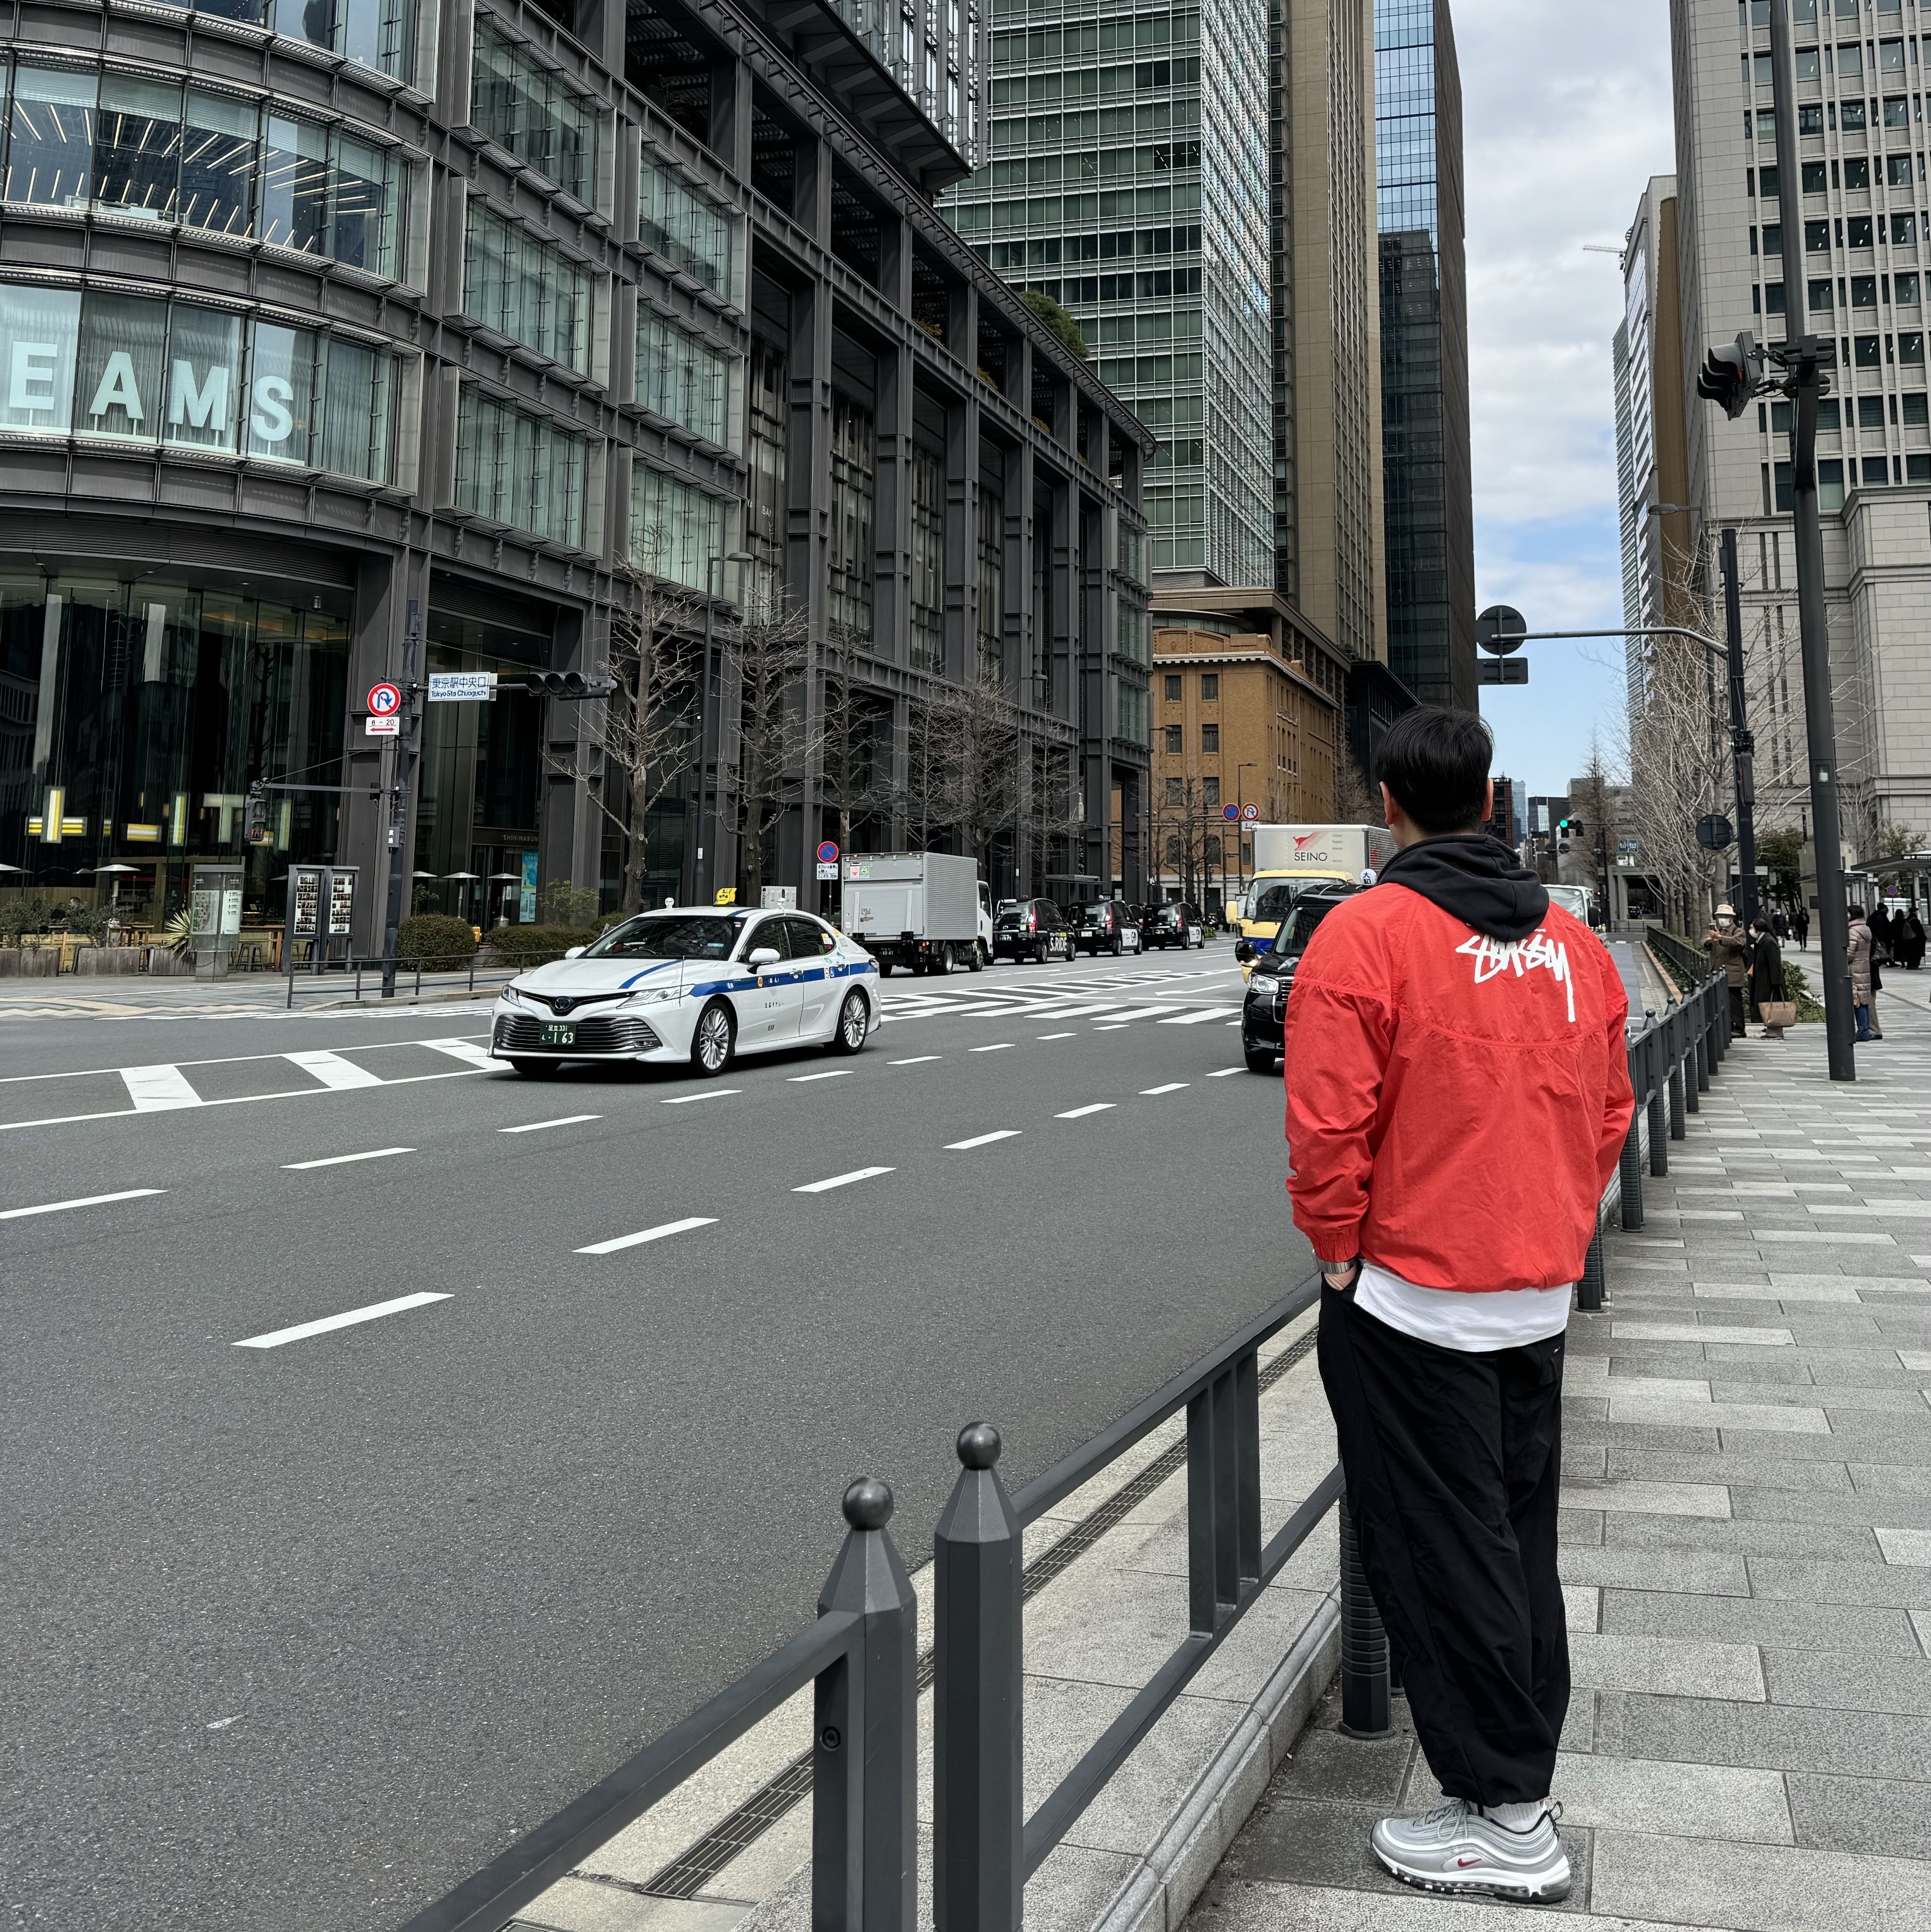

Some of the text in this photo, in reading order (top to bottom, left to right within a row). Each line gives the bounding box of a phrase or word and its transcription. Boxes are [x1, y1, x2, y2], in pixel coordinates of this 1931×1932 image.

[9, 341, 294, 442] EAMS
[432, 677, 486, 689] 東京駅中央口
[1294, 852, 1328, 861] SEINO
[1363, 871, 1371, 884] 大和
[1050, 937, 1067, 951] S.RIDE
